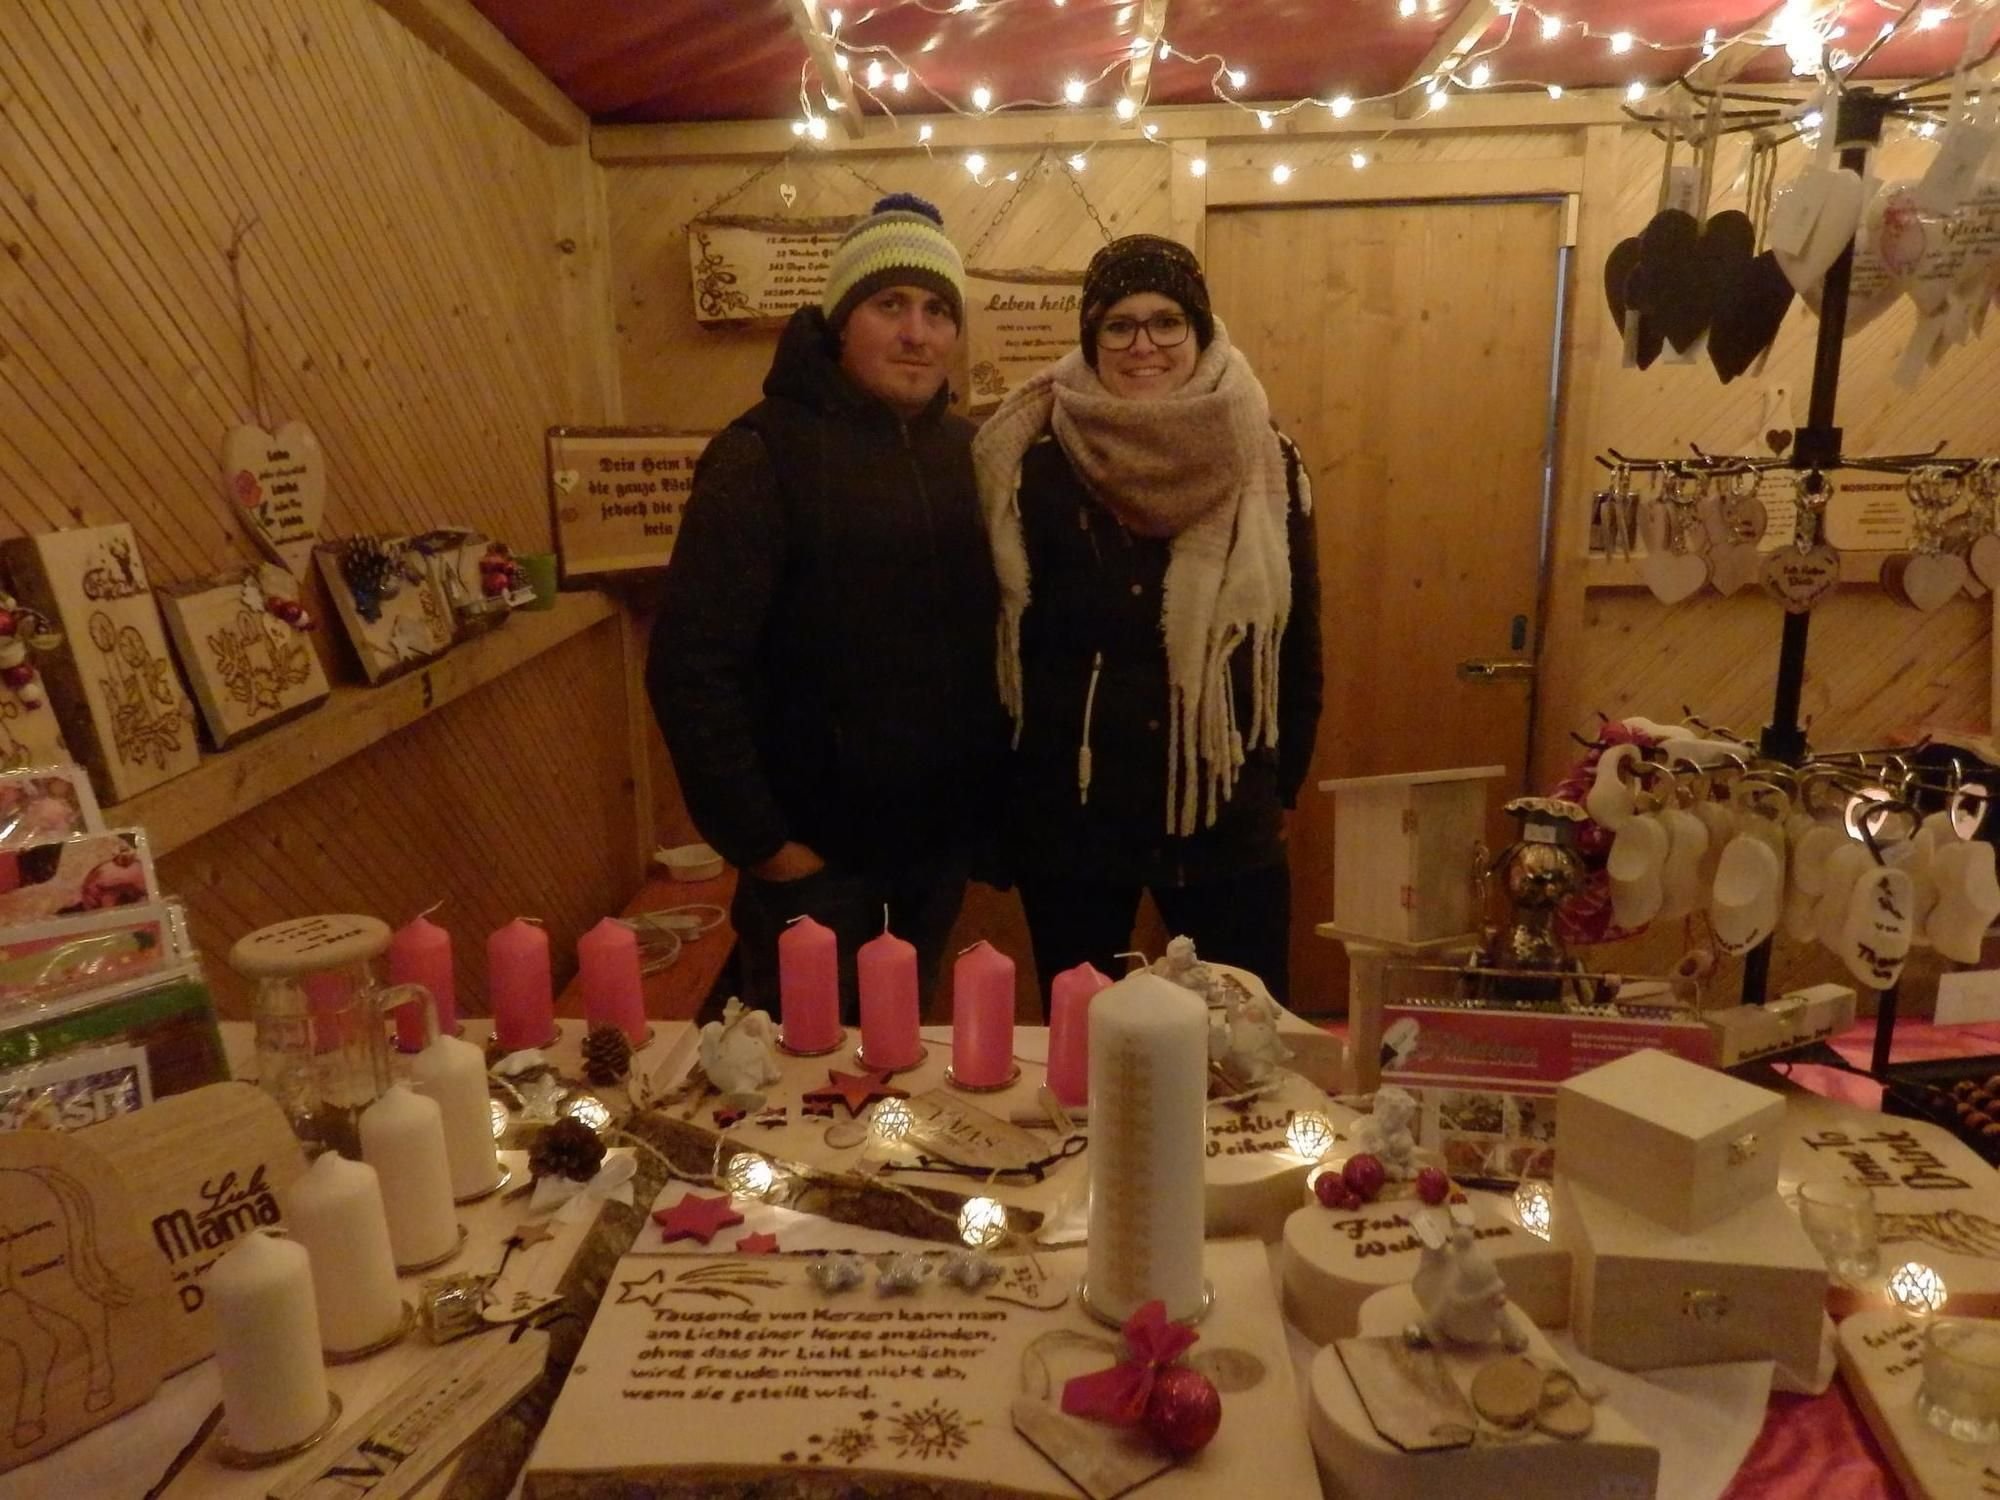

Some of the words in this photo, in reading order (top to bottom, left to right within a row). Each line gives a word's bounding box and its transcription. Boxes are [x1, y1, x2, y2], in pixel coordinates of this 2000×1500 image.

[984, 294, 1036, 311] Leben
[600, 457, 635, 473] Dein
[641, 456, 680, 475] Heim
[588, 480, 610, 496] die
[615, 481, 657, 499] ganze
[601, 502, 648, 521] jedoch
[652, 502, 673, 516] die
[643, 522, 674, 537] kein
[1858, 1130, 1973, 1189] Drink
[151, 1192, 282, 1266] Mama
[1332, 1214, 1410, 1240] Froh
[652, 1308, 763, 1324] Tausende
[769, 1311, 808, 1322] von
[812, 1308, 894, 1323] Kerzen
[898, 1308, 953, 1322] kann
[957, 1310, 1007, 1322] man
[645, 1329, 682, 1341] am
[684, 1327, 743, 1342] Licht
[744, 1328, 805, 1341] einer
[810, 1327, 873, 1341] Kerze
[877, 1326, 997, 1342] anzünden,
[637, 1345, 695, 1360] ohne
[700, 1345, 752, 1360] dass
[757, 1346, 791, 1359] ihr
[796, 1346, 852, 1360] Licht
[858, 1345, 986, 1360] schwächer
[693, 1364, 780, 1380] Freude
[783, 1366, 862, 1379] nimmt
[867, 1364, 925, 1379] nicht
[621, 1389, 686, 1400] wenn
[690, 1385, 725, 1400] sie
[730, 1384, 810, 1403] geteilt
[813, 1384, 877, 1400] wird.
